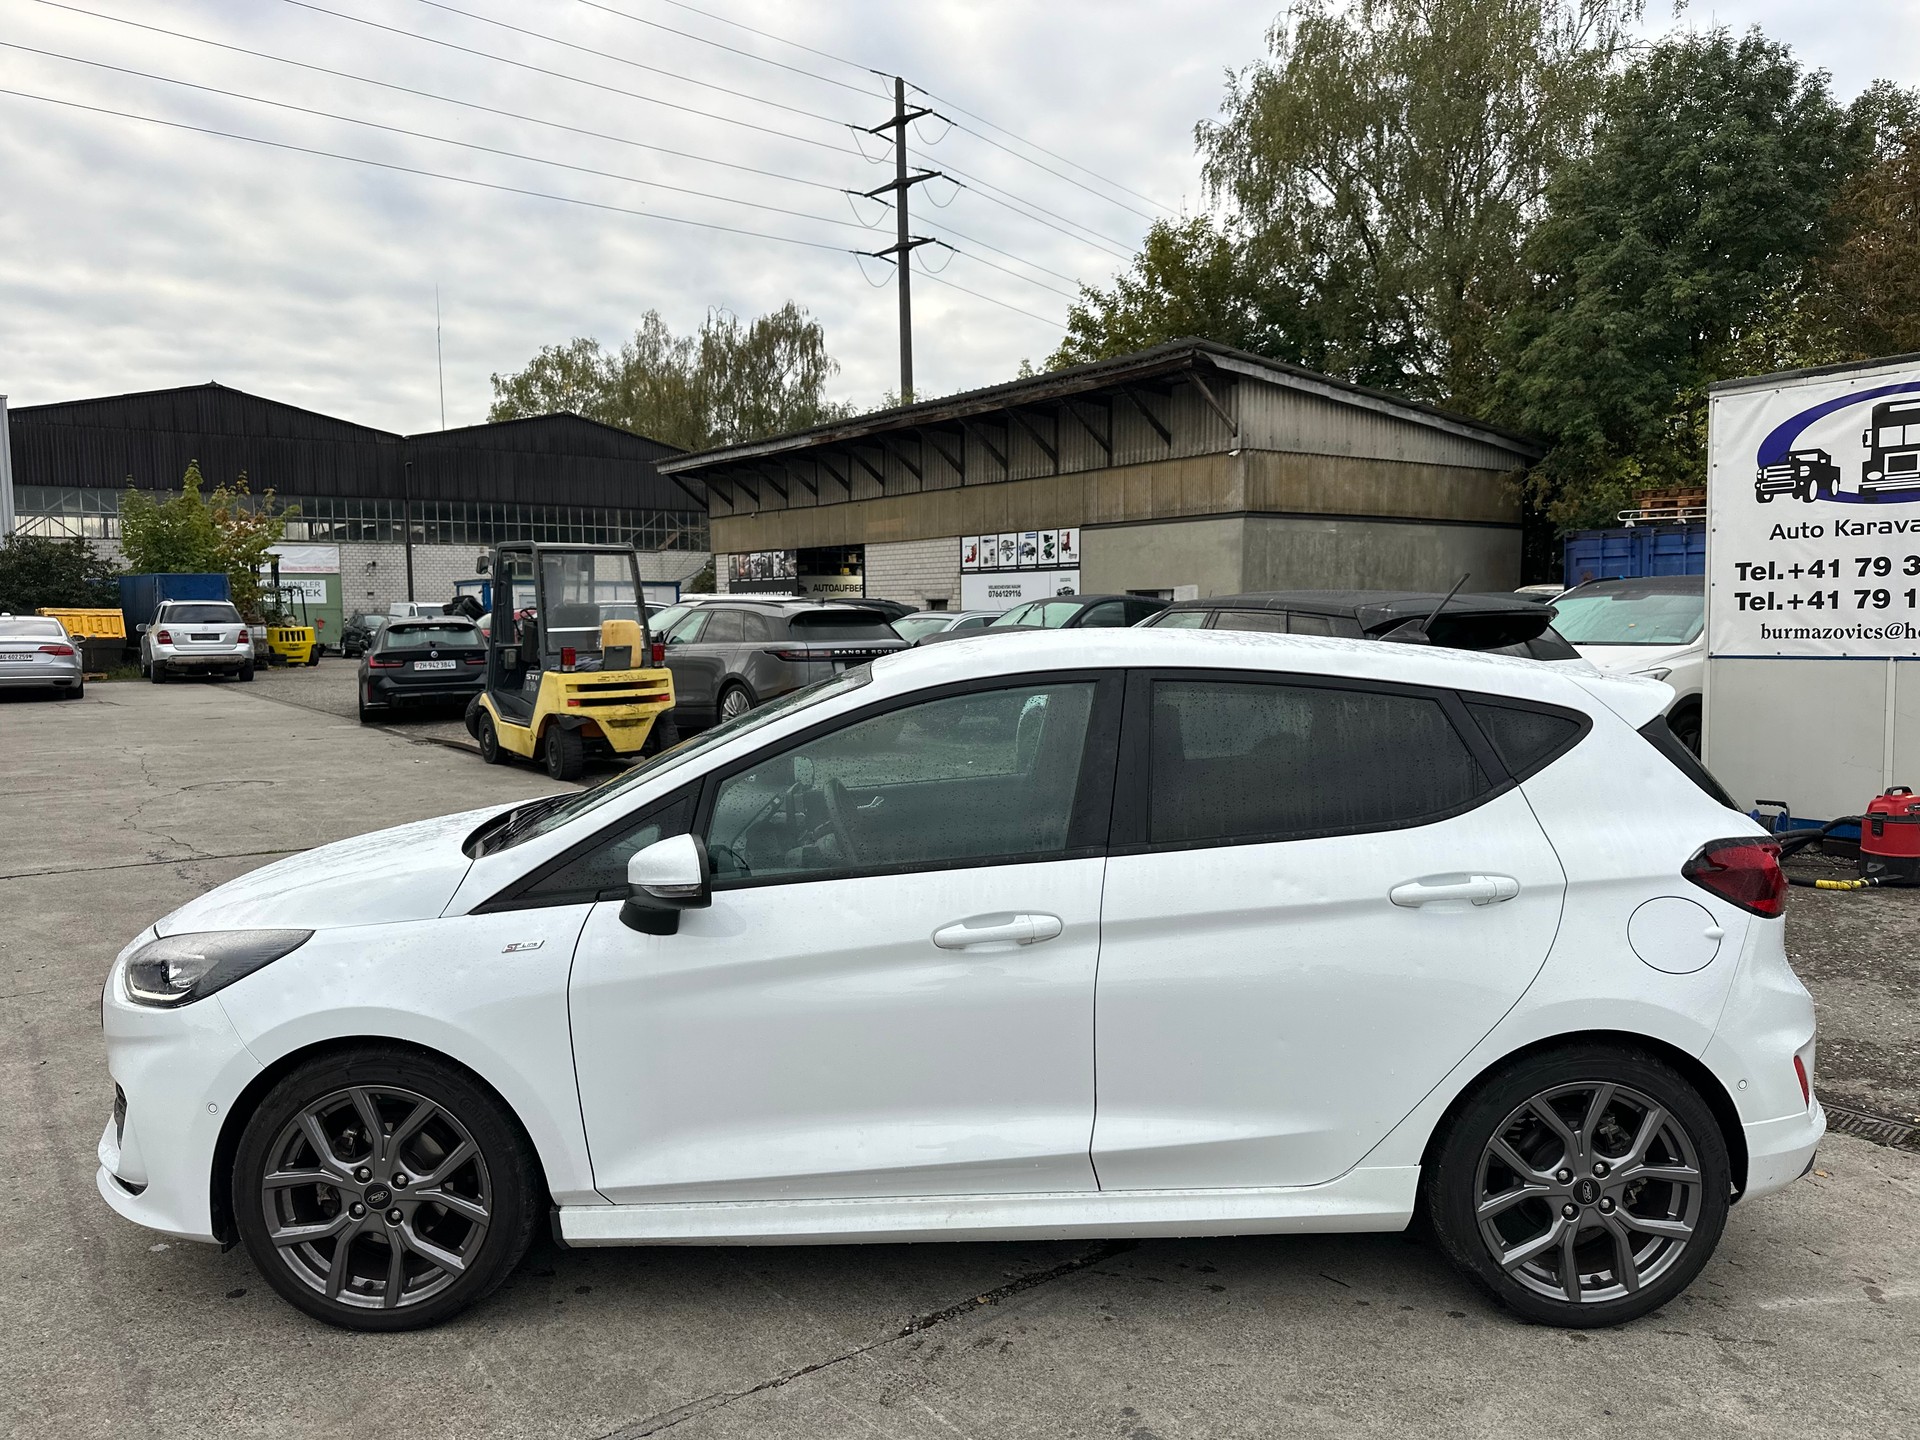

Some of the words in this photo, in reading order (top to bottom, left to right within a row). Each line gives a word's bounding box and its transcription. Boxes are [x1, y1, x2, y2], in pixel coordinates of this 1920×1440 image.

[1769, 522, 1824, 540] Auto
[1735, 559, 1840, 581] Tel.+41
[1854, 556, 1892, 577] 79
[988, 590, 1022, 598] 0766129116
[1734, 590, 1839, 611] Tel.+41
[1853, 588, 1891, 609] 79
[1903, 588, 1917, 608] 1
[1760, 621, 1920, 640] burmazovics@h
